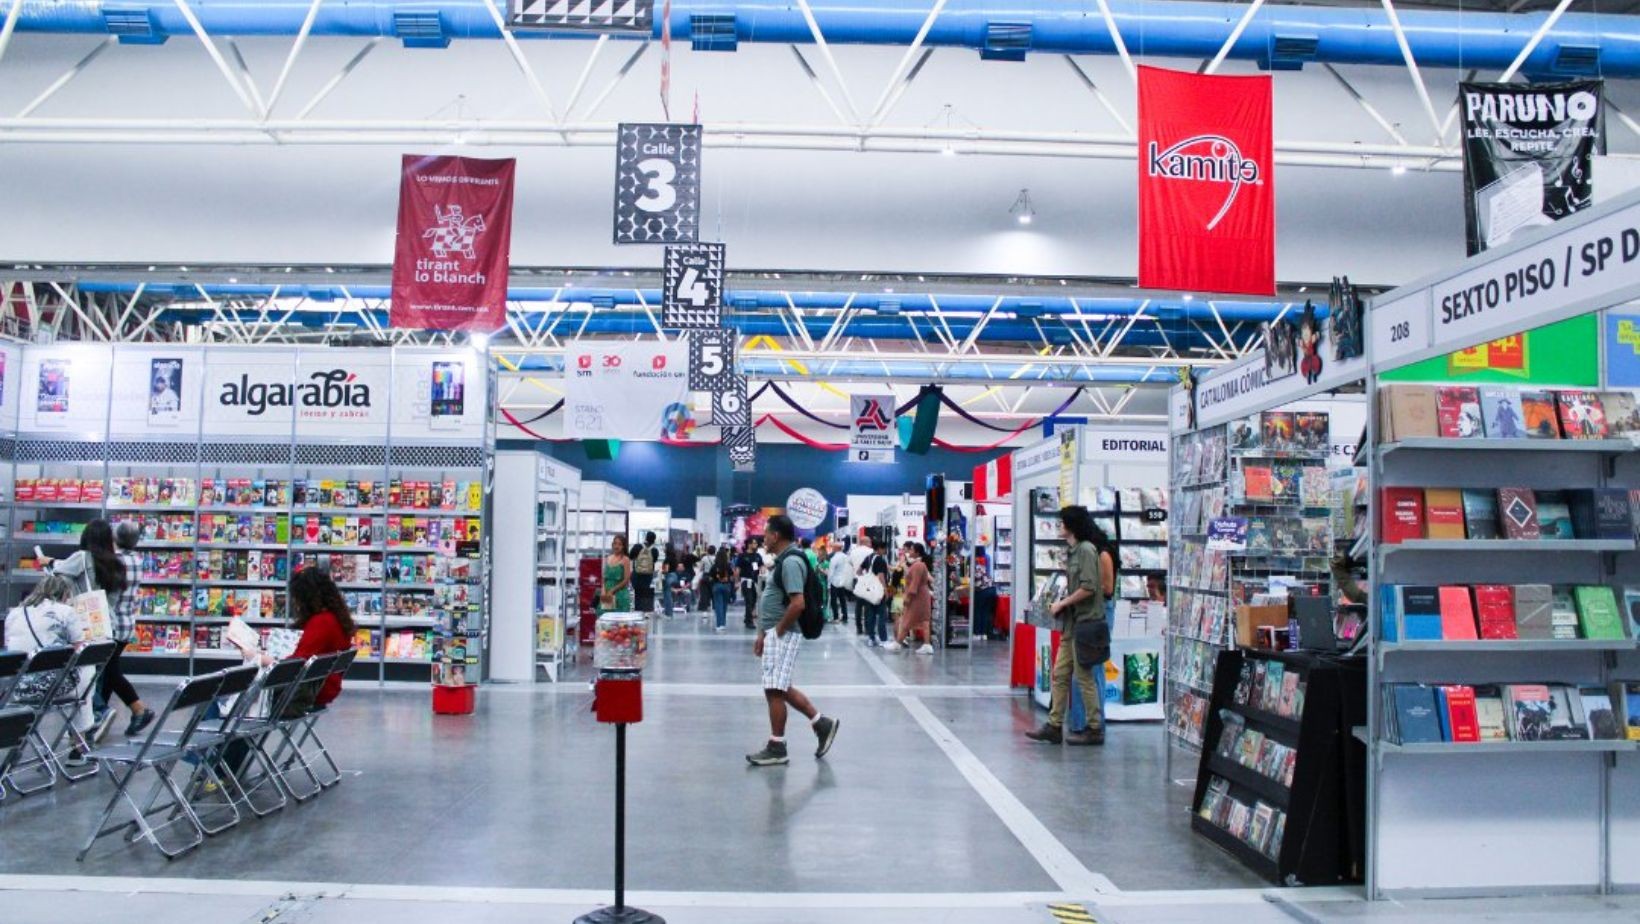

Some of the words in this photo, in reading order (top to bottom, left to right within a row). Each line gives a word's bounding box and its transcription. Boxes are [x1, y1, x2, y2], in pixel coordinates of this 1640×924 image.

[1465, 91, 1597, 122] PARUNO
[1495, 128, 1560, 139] ESCUCHA,
[643, 142, 675, 155] Calle
[1511, 140, 1557, 151] REPITE.
[634, 157, 677, 213] 3
[416, 258, 460, 271] tirant
[682, 256, 707, 266] Calle
[415, 270, 429, 283] lo
[433, 270, 486, 285] blanch
[676, 267, 710, 307] 4
[1441, 278, 1500, 325] SEXTO
[1504, 257, 1556, 303] PISO
[1562, 245, 1573, 289] /
[1580, 236, 1614, 277] SP
[1390, 320, 1411, 343] 208
[602, 354, 622, 368] 30
[700, 346, 724, 376] 5
[577, 369, 592, 377] sm
[219, 368, 372, 415] algarabía
[1200, 378, 1240, 410] CATALONIA
[1240, 367, 1270, 394] CÓMIC
[720, 389, 741, 413] 6
[1102, 438, 1167, 452] EDITORIAL
